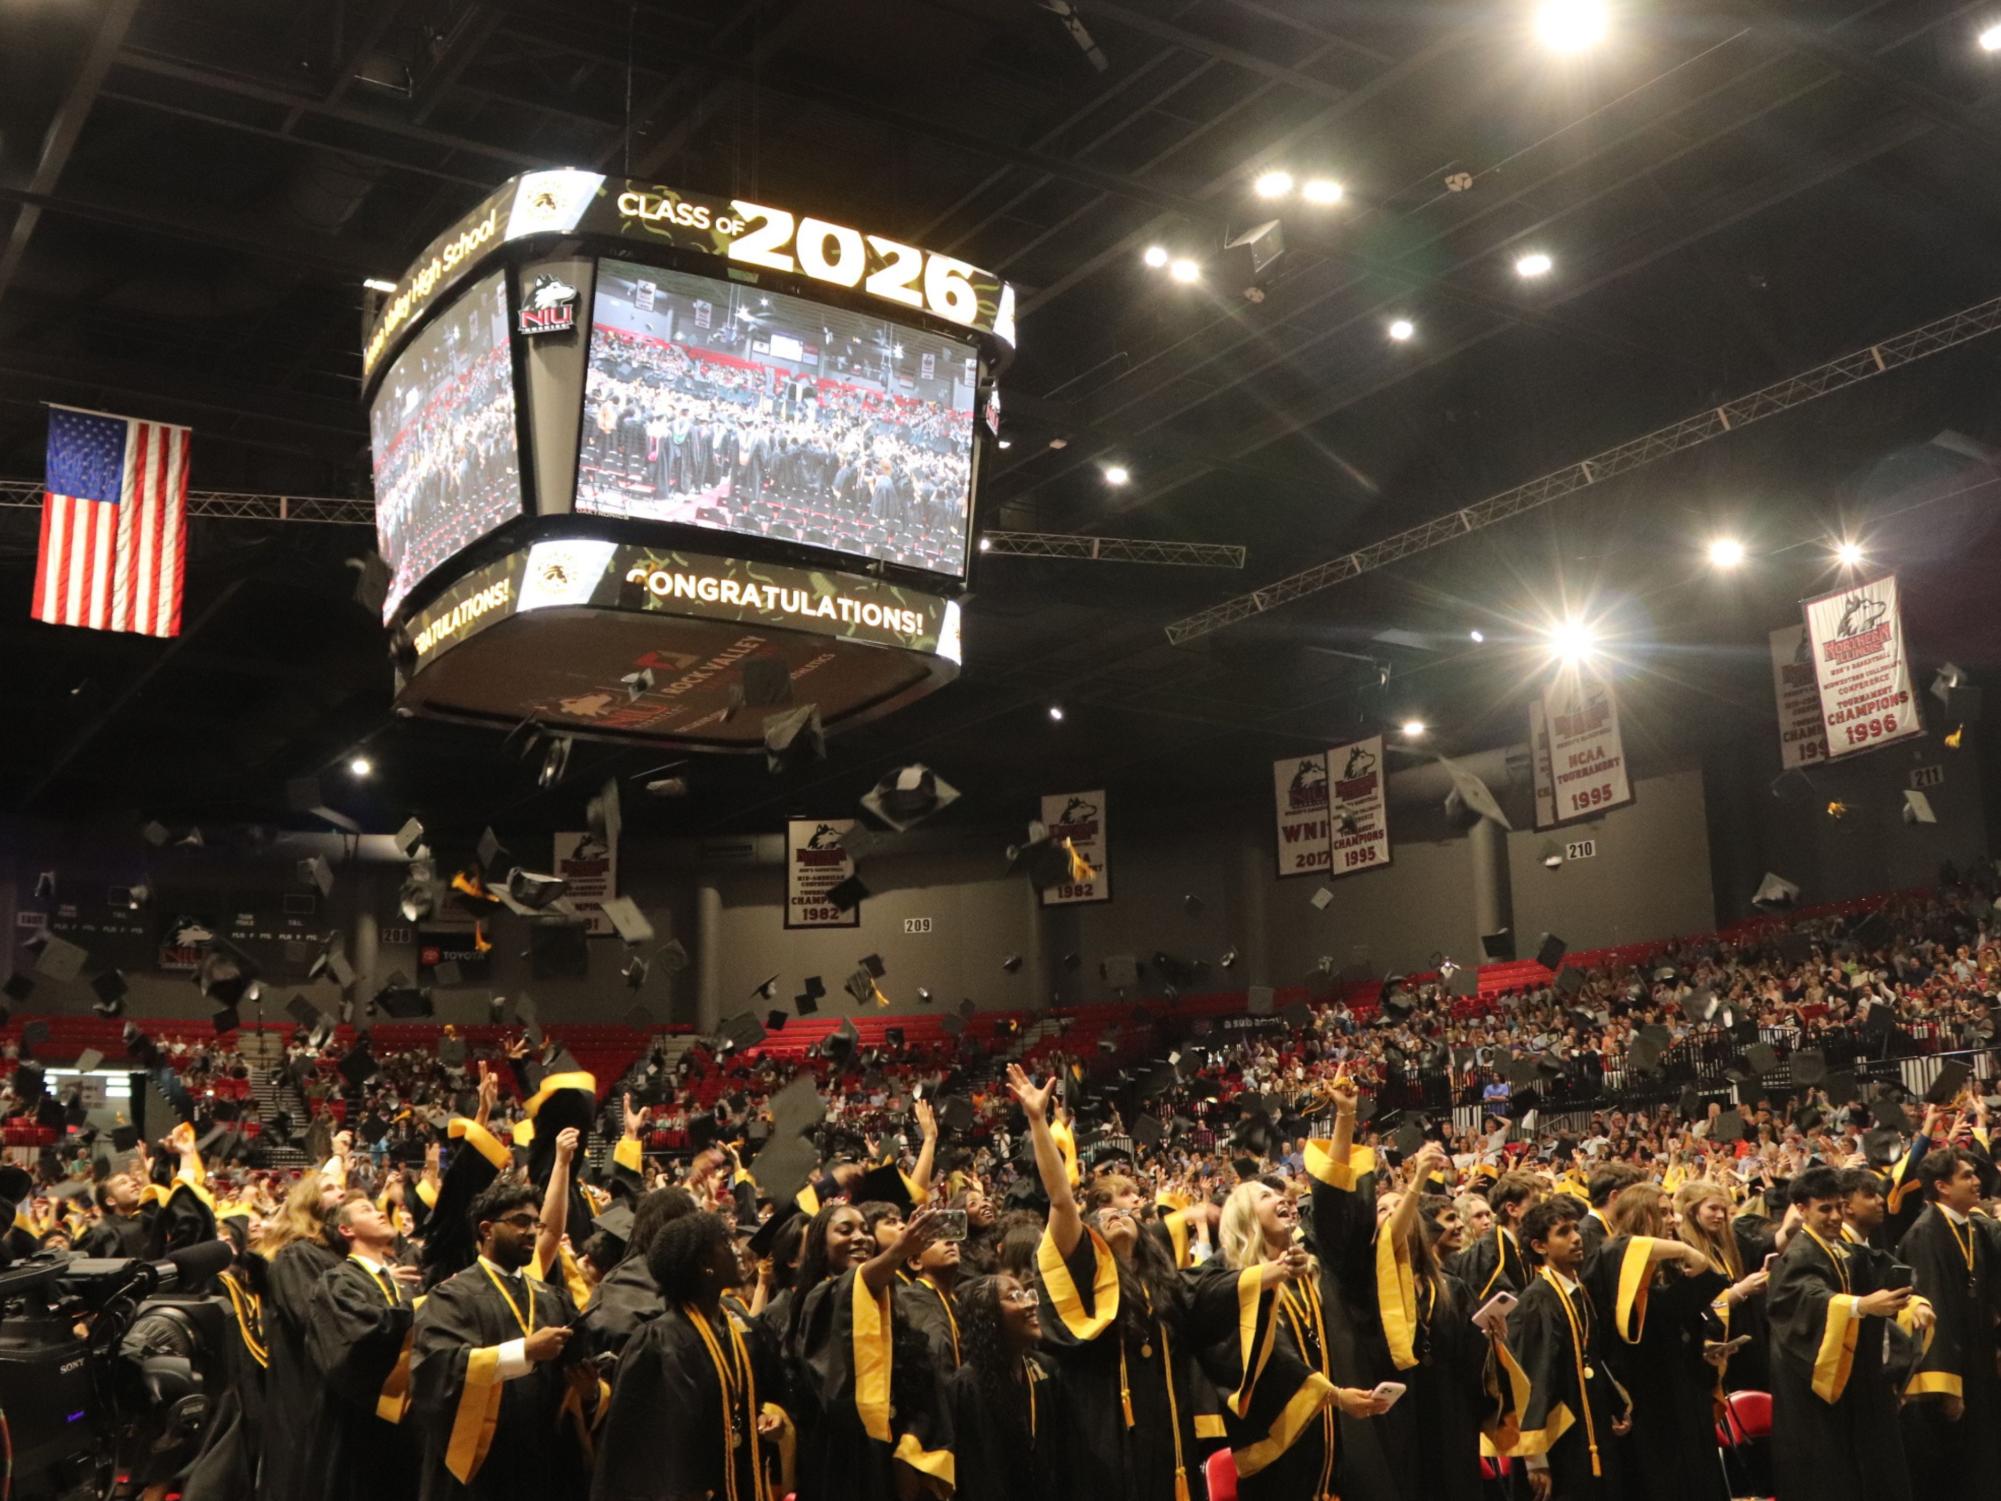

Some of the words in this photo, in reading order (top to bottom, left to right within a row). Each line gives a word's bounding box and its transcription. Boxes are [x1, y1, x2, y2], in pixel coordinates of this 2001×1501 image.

[617, 192, 711, 230] CLASS
[715, 216, 746, 236] OF
[412, 257, 441, 303] High
[443, 208, 496, 272] School
[728, 199, 978, 325] 2026
[520, 304, 572, 328] NIU
[1822, 622, 1893, 662] NORTHERN
[661, 670, 715, 695] ROCK
[699, 635, 767, 670] VALLEY
[1838, 673, 1889, 696] CONFERENCE
[1827, 690, 1909, 726] CHAMPIONS
[1837, 685, 1893, 709] TOURNAMENT
[1845, 713, 1898, 745] 1996
[1568, 746, 1605, 769] NCAA
[1557, 757, 1620, 785] TOURNAMENT
[1914, 767, 1938, 786] 211
[1571, 783, 1613, 811] 1995
[1281, 820, 1330, 844] WNI
[1333, 829, 1385, 850] CHAMPIONS
[1296, 851, 1330, 868] 2017
[1345, 846, 1376, 867] 1995
[1569, 841, 1593, 859] 210
[1058, 884, 1094, 899] 1982
[802, 907, 840, 921] 1982
[905, 918, 930, 932] 209
[443, 951, 485, 960] TOYOTA
[60, 1357, 85, 1375] SONY
